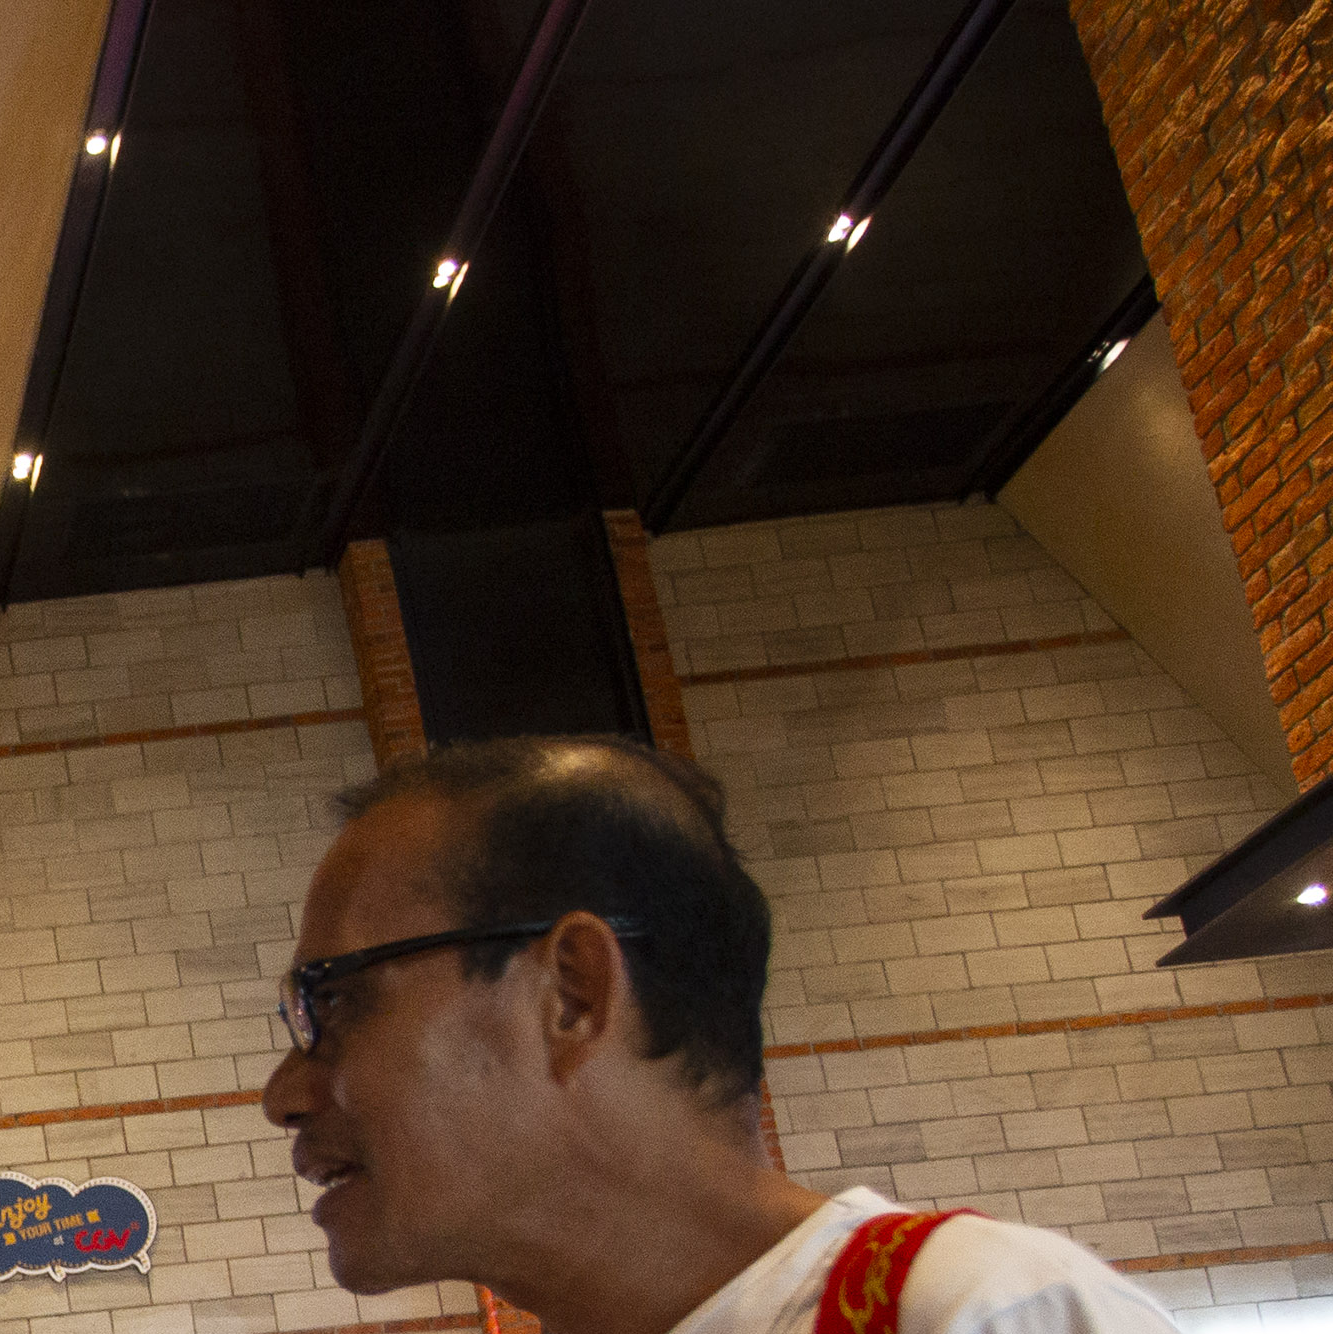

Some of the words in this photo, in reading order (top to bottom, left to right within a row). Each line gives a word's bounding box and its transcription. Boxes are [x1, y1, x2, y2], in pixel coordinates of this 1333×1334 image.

[19, 1221, 52, 1241] YOUR
[53, 1213, 84, 1231] TIME
[74, 1228, 131, 1253] CGV
